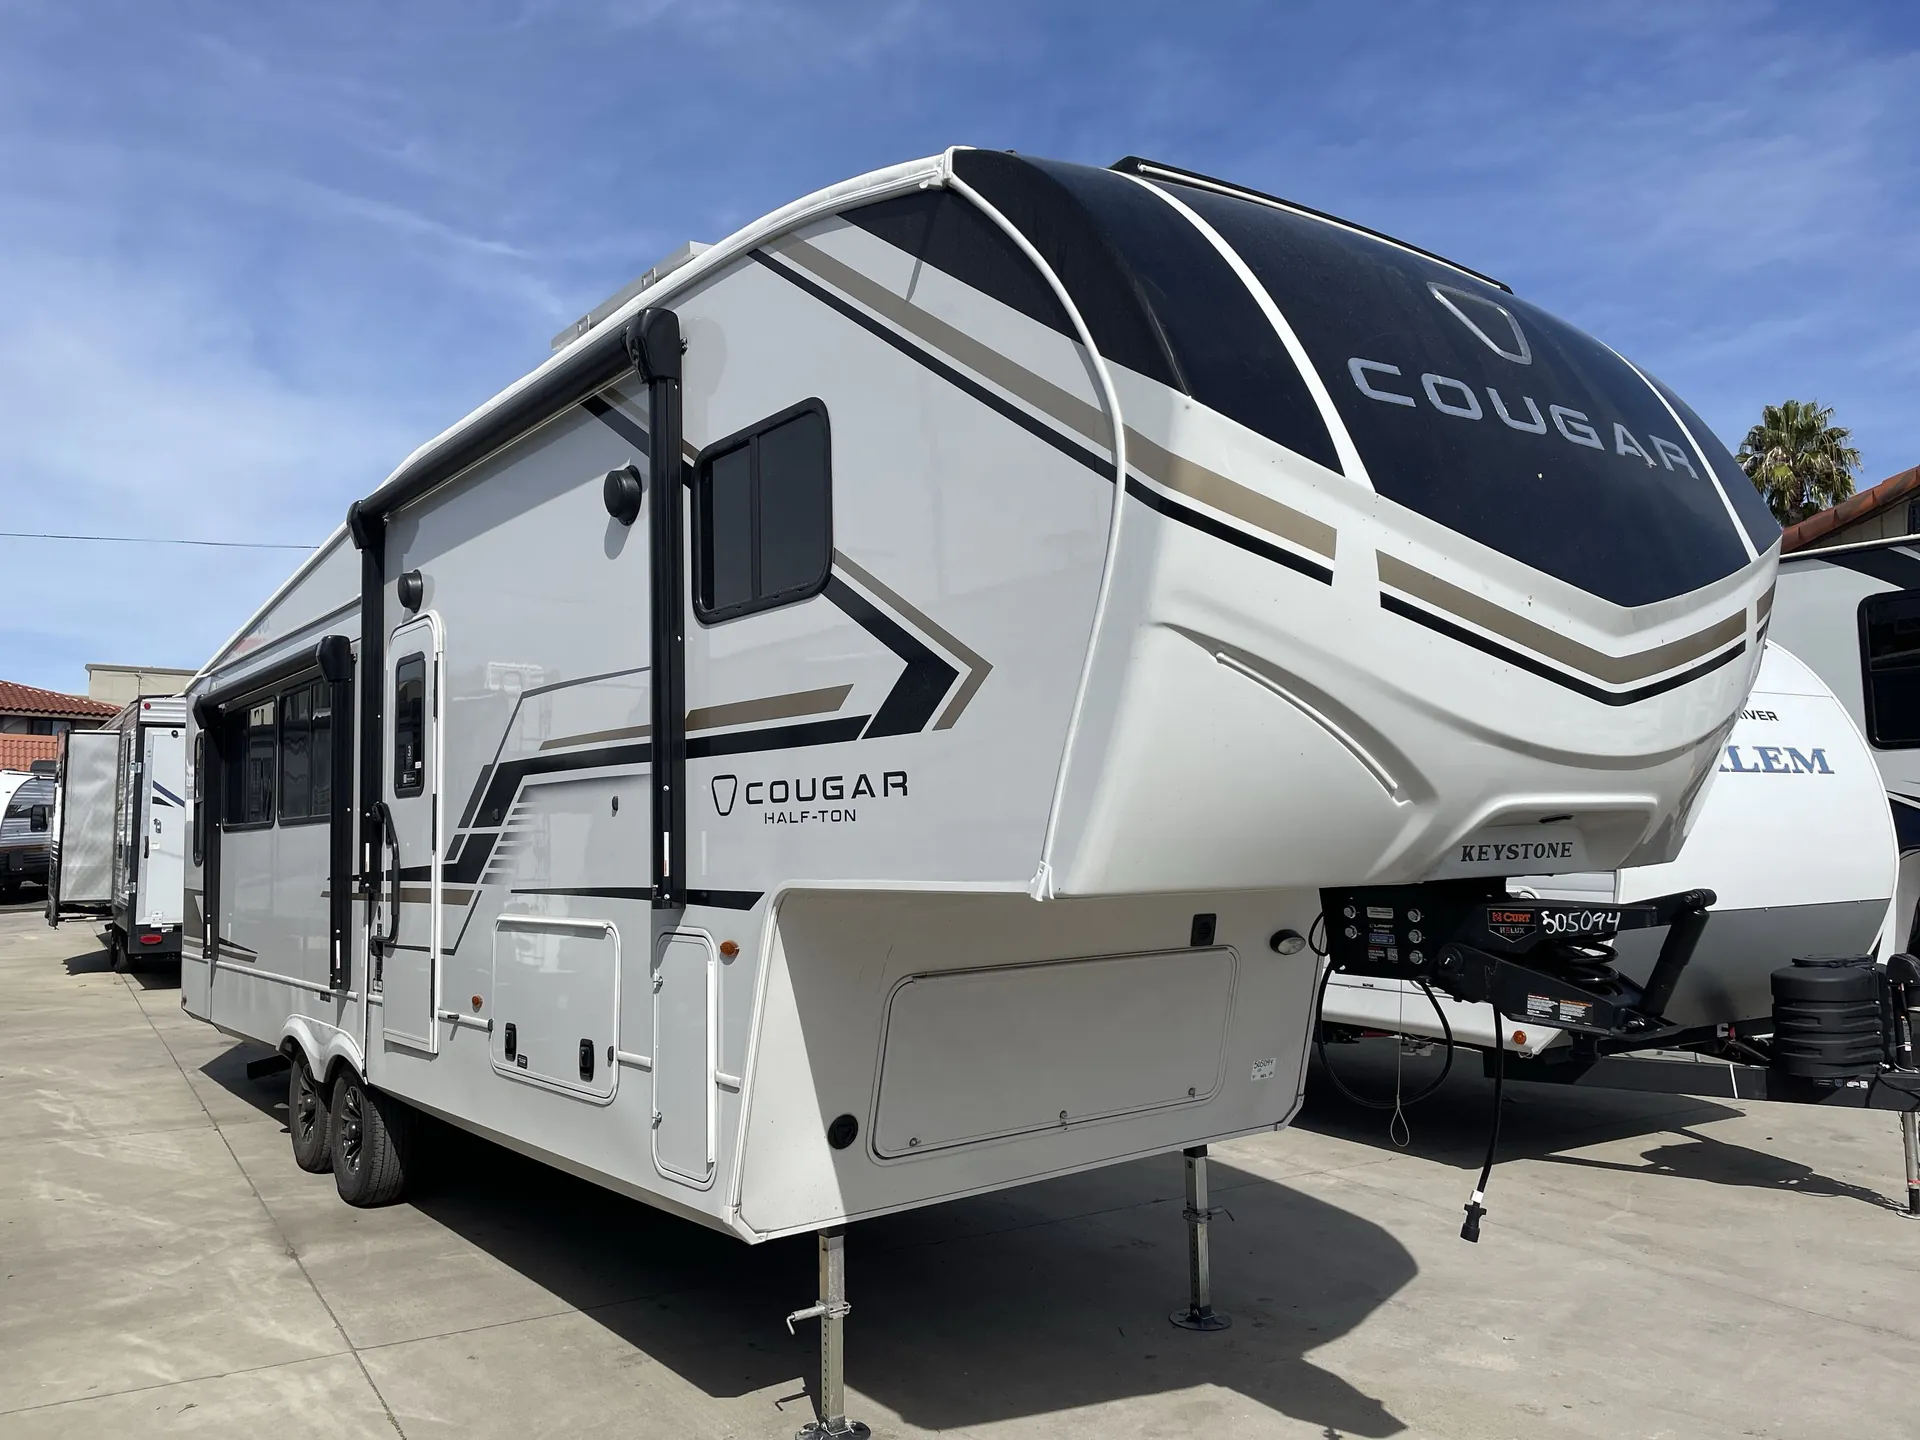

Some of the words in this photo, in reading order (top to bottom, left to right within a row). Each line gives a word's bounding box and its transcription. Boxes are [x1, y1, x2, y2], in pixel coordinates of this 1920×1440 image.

[1347, 357, 1699, 480] COUGAR
[1740, 709, 1780, 722] IVER
[1719, 745, 1836, 775] LEM
[745, 770, 908, 805] COUGAR
[764, 808, 856, 824] HALF-TON
[1460, 841, 1573, 862] KEYSTONE
[1503, 912, 1531, 923] CURT
[1540, 910, 1621, 935] 505094
[1499, 926, 1525, 935] HELUX
